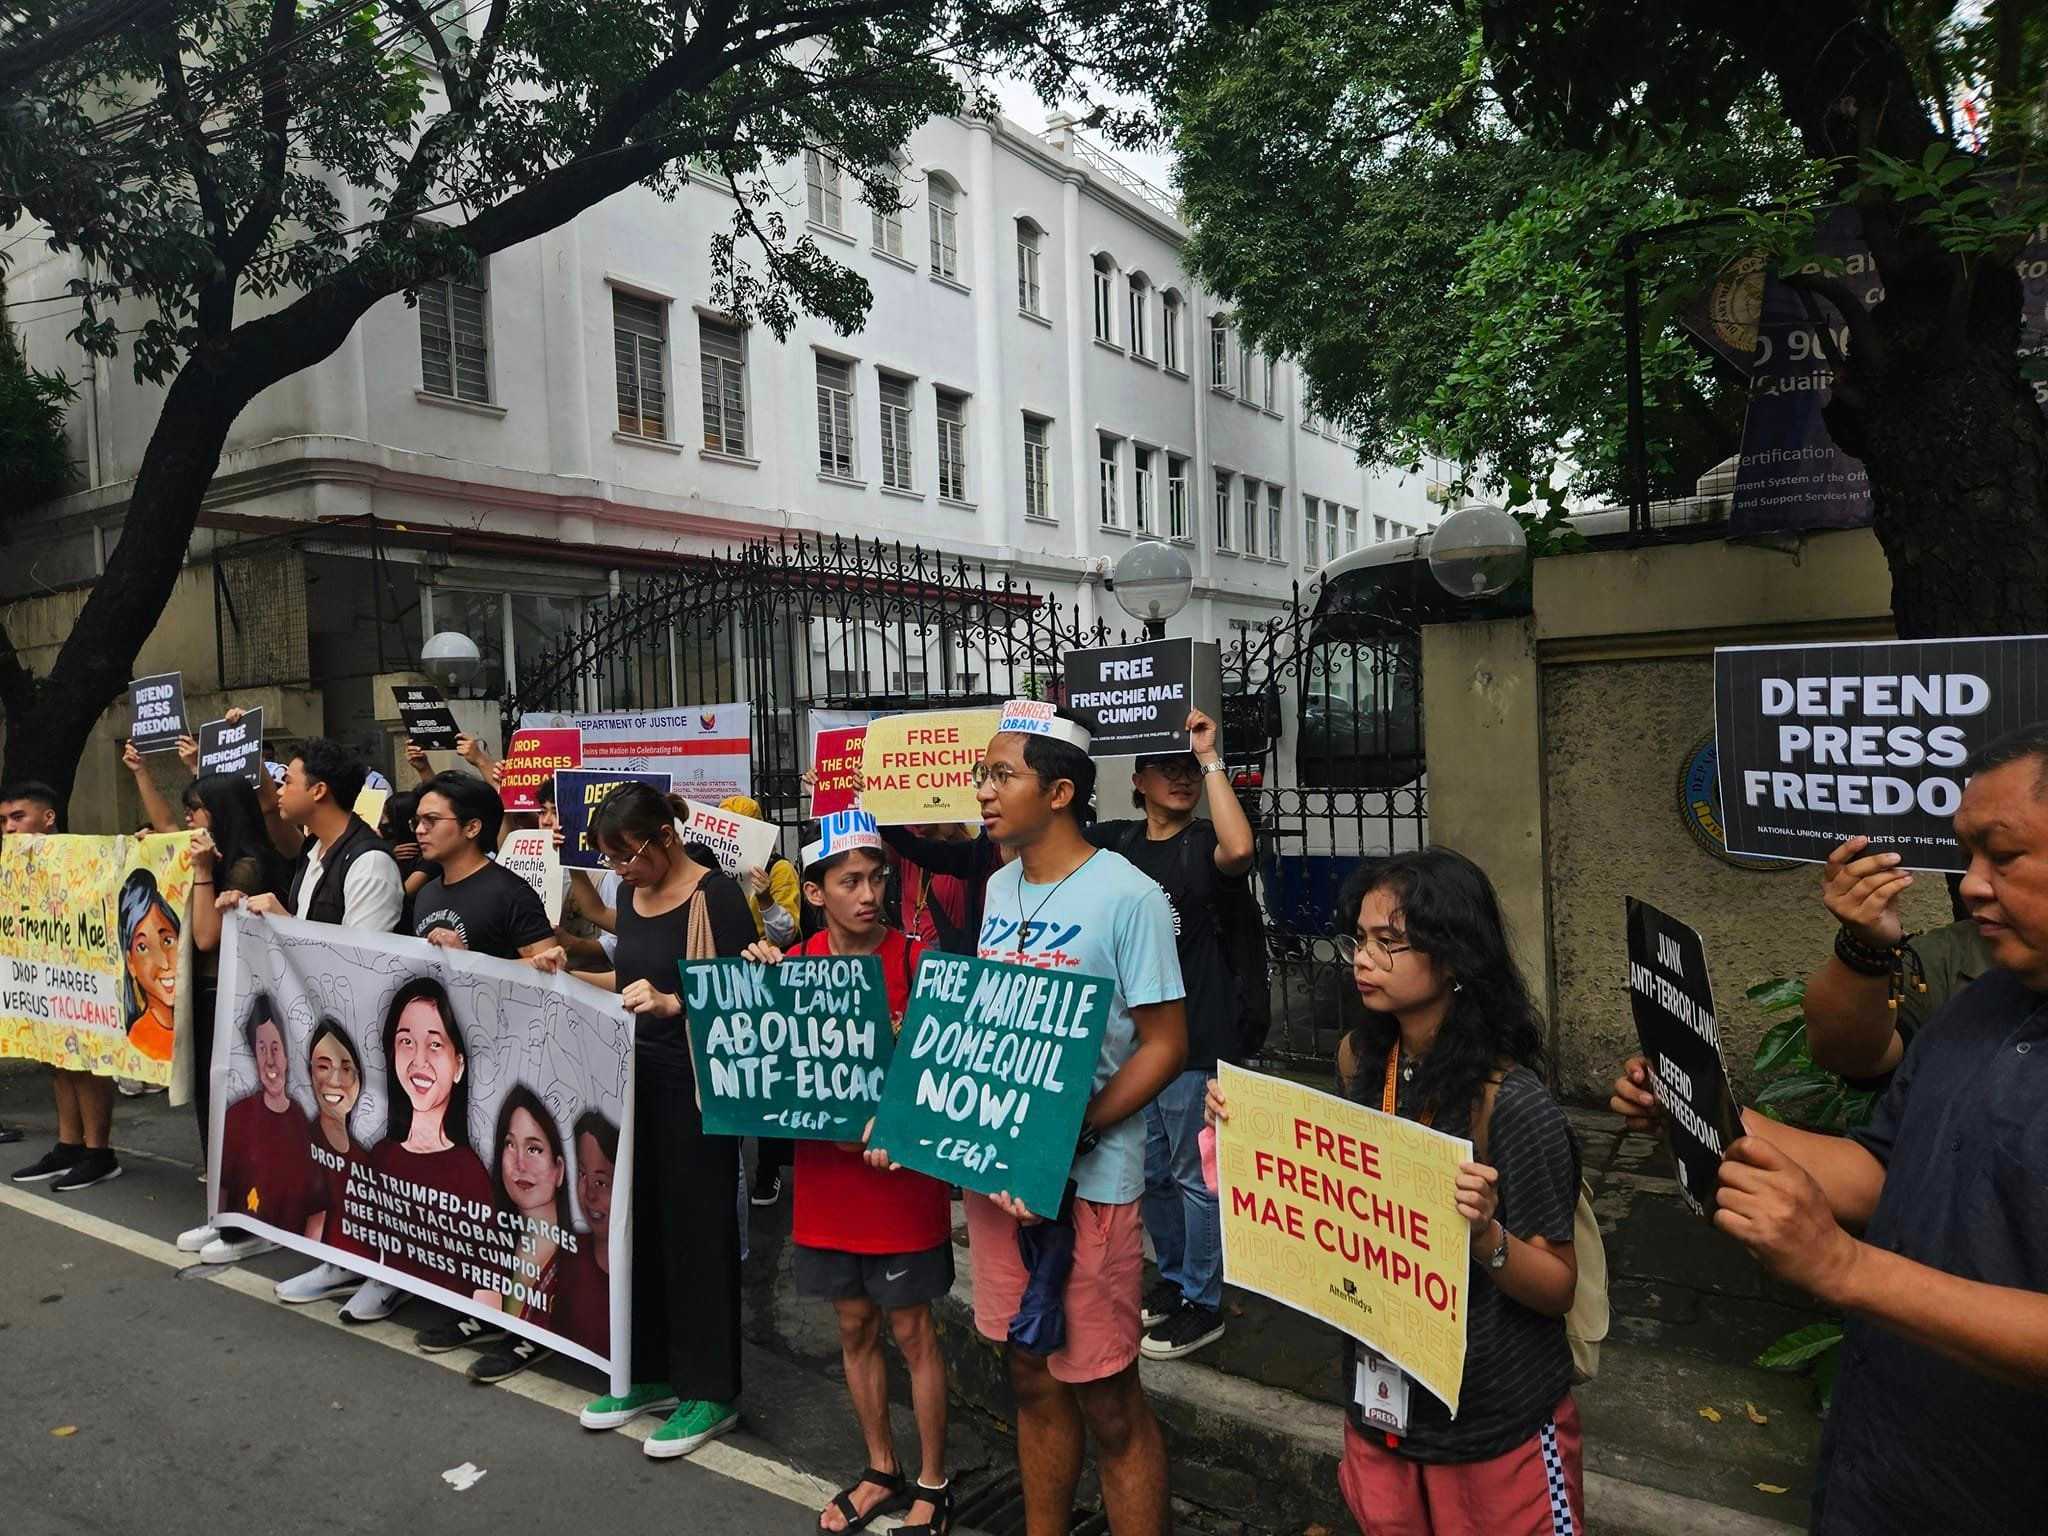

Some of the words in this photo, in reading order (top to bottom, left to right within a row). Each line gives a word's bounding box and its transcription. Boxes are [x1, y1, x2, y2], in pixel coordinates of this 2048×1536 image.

[1742, 447, 1835, 467] ertification
[1768, 475, 1808, 488] System
[1812, 472, 1824, 482] of
[1827, 472, 1844, 482] the
[1737, 498, 1758, 510] and
[1760, 495, 1802, 507] Support
[1806, 492, 1846, 502] Services
[1850, 491, 1860, 500] in
[1100, 657, 1154, 682] FREE
[136, 684, 174, 705] DEFEND
[1072, 688, 1146, 708] FRENCHIE
[1148, 684, 1184, 702] MAE
[1761, 674, 1991, 717] DEFEND
[138, 701, 170, 720] PRESS
[576, 718, 632, 731] DEPARTMENT
[635, 718, 646, 729] OF
[650, 716, 688, 728] JUSTICE
[1008, 702, 1052, 720] CHARGES
[1098, 705, 1158, 724] CUMPIO
[132, 716, 181, 737] FREEDOM
[218, 724, 246, 746] FREE
[907, 728, 960, 746] FREE
[514, 740, 540, 752] DROP
[636, 746, 671, 755] Celebrating
[882, 748, 986, 768] FRENCHIE
[1778, 725, 1969, 767] PRESS
[513, 756, 572, 768] CHARGES
[822, 758, 842, 772] THE
[867, 774, 911, 791] MAE
[1744, 770, 1967, 817] FREEDO
[693, 812, 741, 839] FREE
[1757, 826, 1796, 836] NATIONAL
[1796, 829, 1821, 838] UNION
[1822, 832, 1834, 840] OF
[1835, 833, 1896, 844] JOULISTS
[1898, 835, 1912, 844] OF
[1914, 836, 1933, 845] THE
[1936, 838, 1959, 846] PHIL
[512, 840, 544, 856] FREE
[683, 826, 743, 857] Frenchie,
[504, 857, 547, 874] Frenchie,
[1657, 932, 1684, 978] JUNK
[12, 961, 38, 984] DROP
[46, 967, 98, 995] CHARGES
[686, 960, 774, 1010] JUNK
[776, 959, 871, 991] TERROR
[4, 991, 49, 1018] VERSUS
[794, 990, 860, 1016] LAW!
[916, 959, 970, 1003] FREE
[964, 968, 1098, 1038] MARIELLE
[1631, 961, 1692, 1029] ANTI-TERROR
[706, 1012, 875, 1060] ABOLISH
[910, 1014, 1064, 1093] DOMEQUIL
[709, 1054, 884, 1102] NTF-ELCAC
[1660, 1052, 1693, 1102] DEFEND
[916, 1068, 1030, 1138] NOW!
[1670, 1093, 1722, 1156] FREEDOM!
[1294, 1118, 1382, 1180] FREE
[310, 1143, 345, 1172] DROP
[350, 1162, 376, 1185] ALL
[380, 1173, 492, 1223] TRUMPED-UP
[497, 1211, 578, 1254] CHARGES
[1256, 1150, 1430, 1251] FRENCHIE
[346, 1179, 411, 1217] AGAINST
[416, 1206, 514, 1249] TACLOBAN
[520, 1235, 536, 1256] 5!
[344, 1200, 374, 1222] FREE
[378, 1210, 440, 1246] FRENCHIE
[442, 1236, 474, 1258] MAE
[478, 1247, 540, 1281] CUMPIO!
[1232, 1186, 1306, 1240] MAE
[1314, 1218, 1457, 1322] CUMPIO!
[342, 1218, 402, 1254] DEFEND
[406, 1242, 456, 1274] PRESS
[461, 1262, 547, 1312] FREEDOM!
[1329, 1284, 1373, 1314] Altermidya
[1370, 1408, 1397, 1428] PRESS
